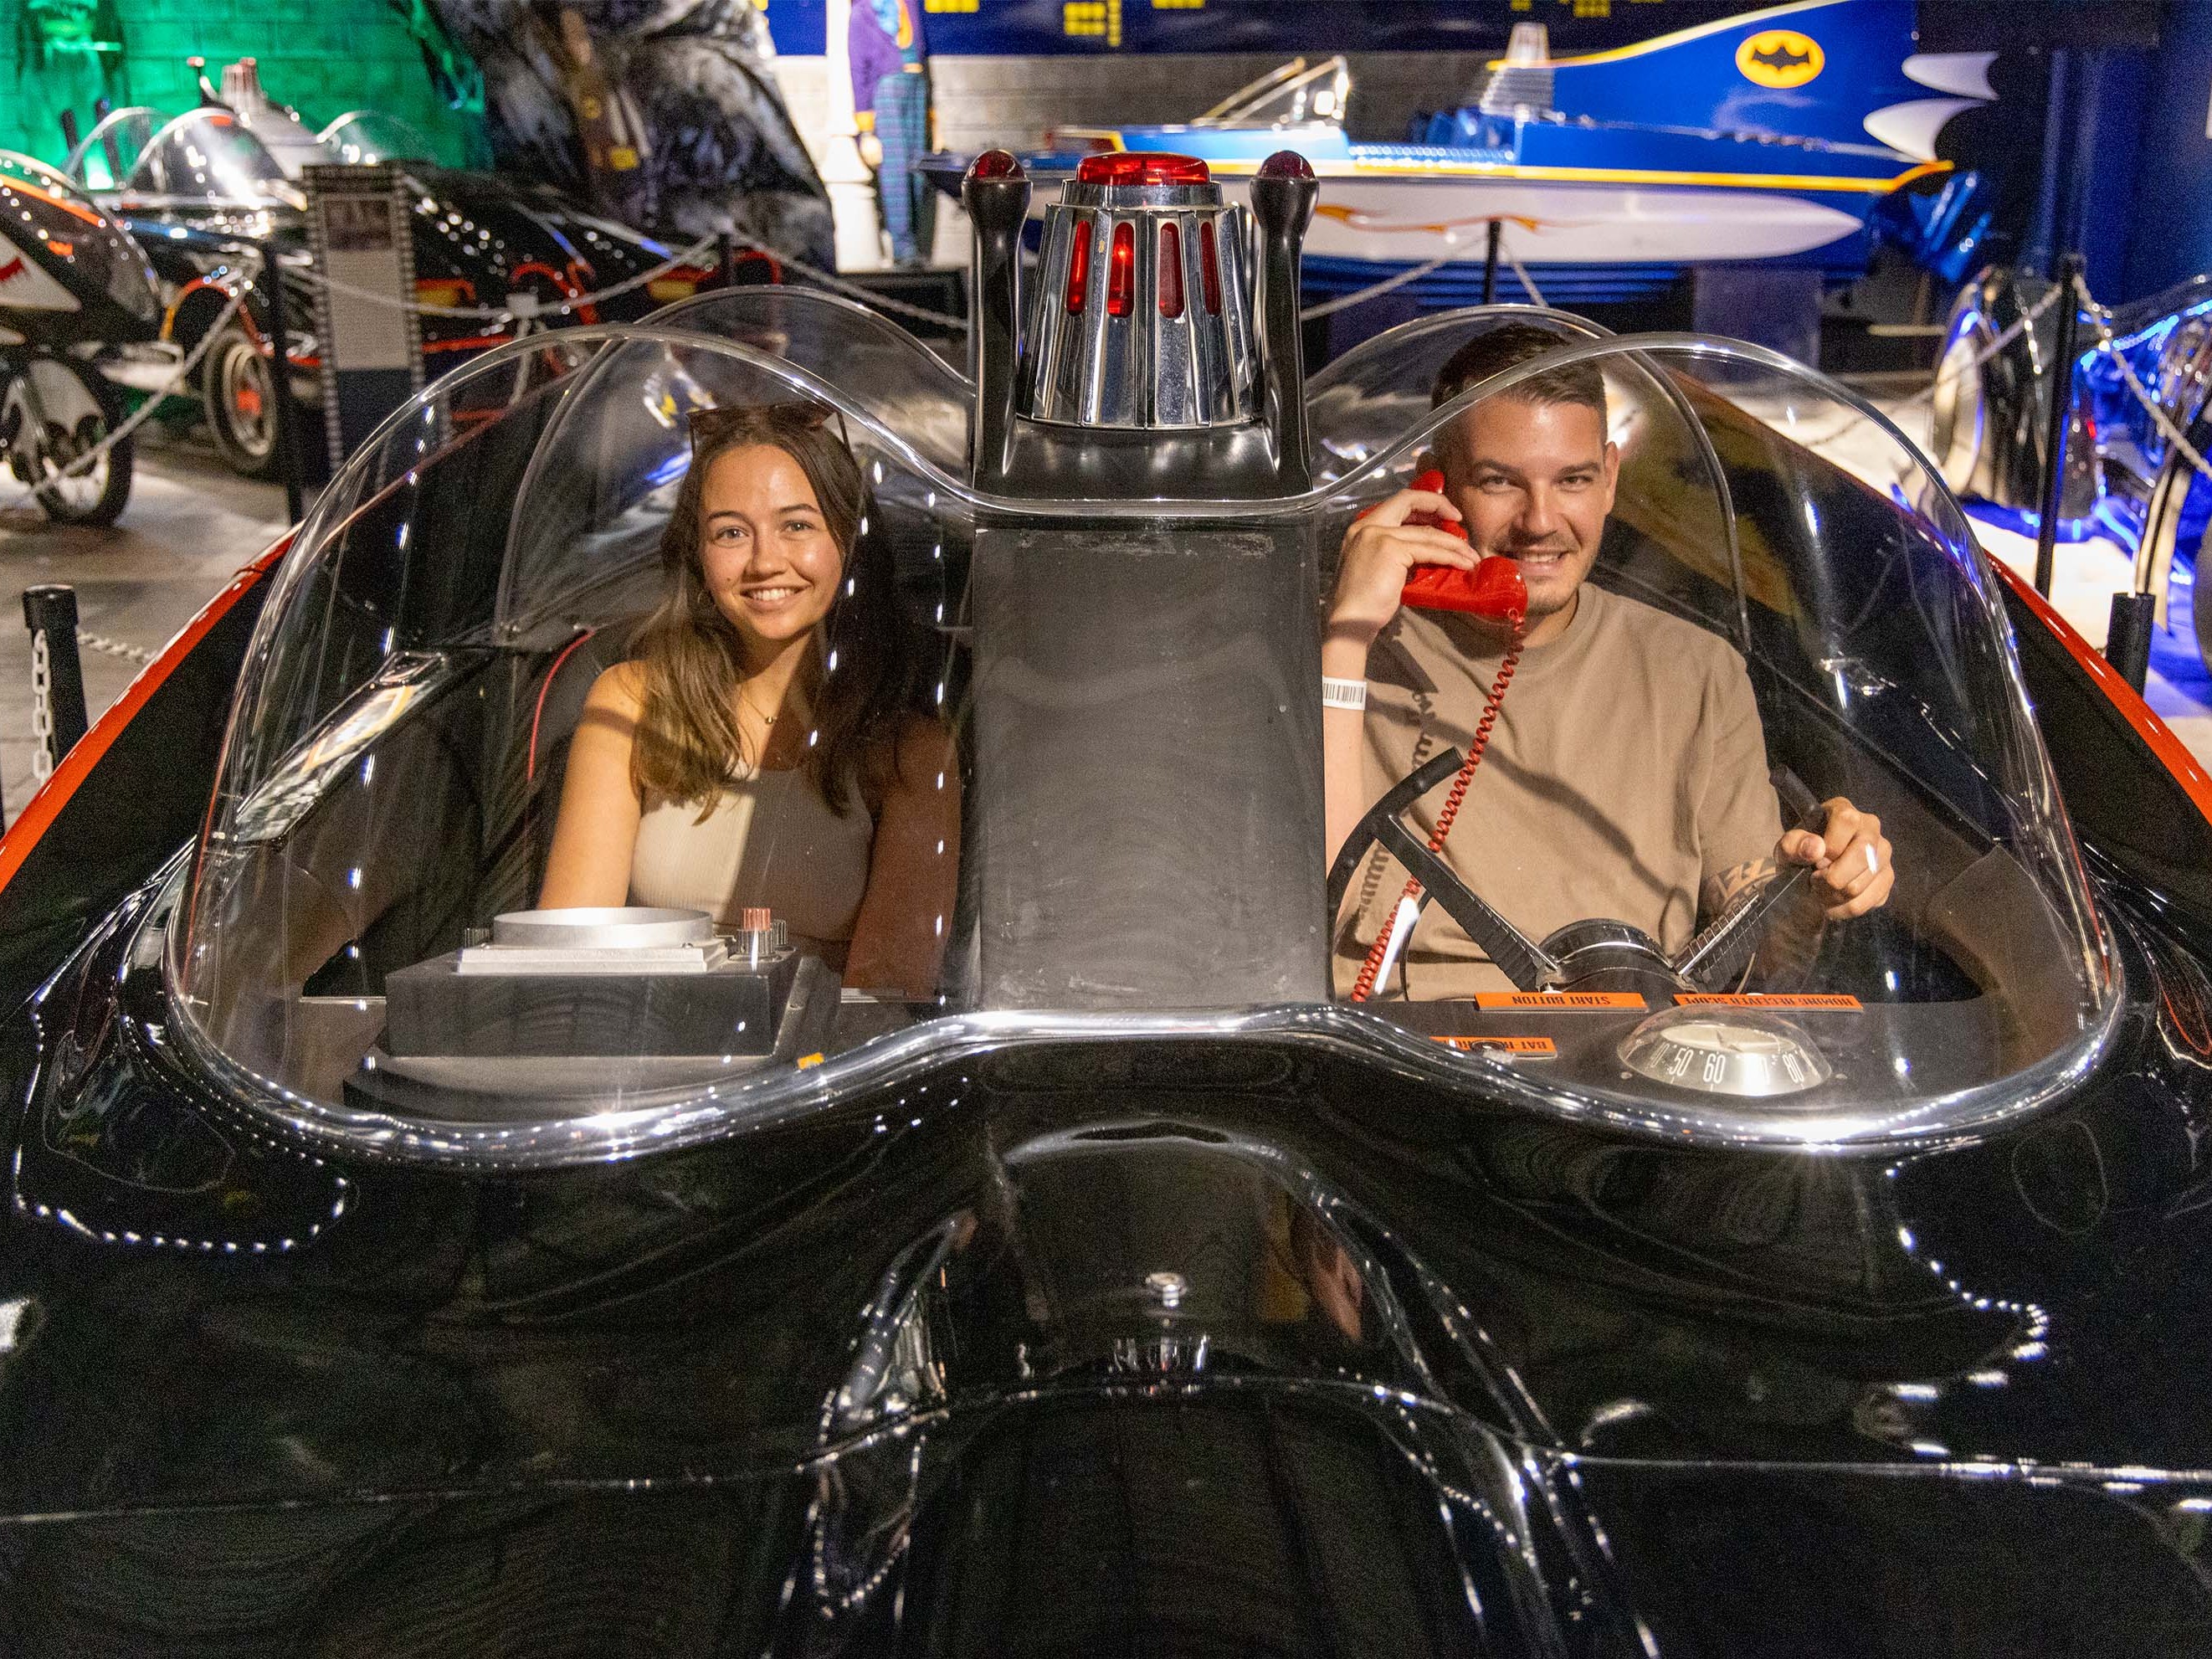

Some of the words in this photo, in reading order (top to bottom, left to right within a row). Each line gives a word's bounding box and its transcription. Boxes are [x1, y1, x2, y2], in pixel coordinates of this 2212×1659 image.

[1511, 996, 1566, 1005] BUTTON
[1569, 996, 1611, 1005] START
[1668, 1047, 1694, 1077] 50
[1702, 1053, 1726, 1084] 60
[1782, 1053, 1804, 1084] 80
